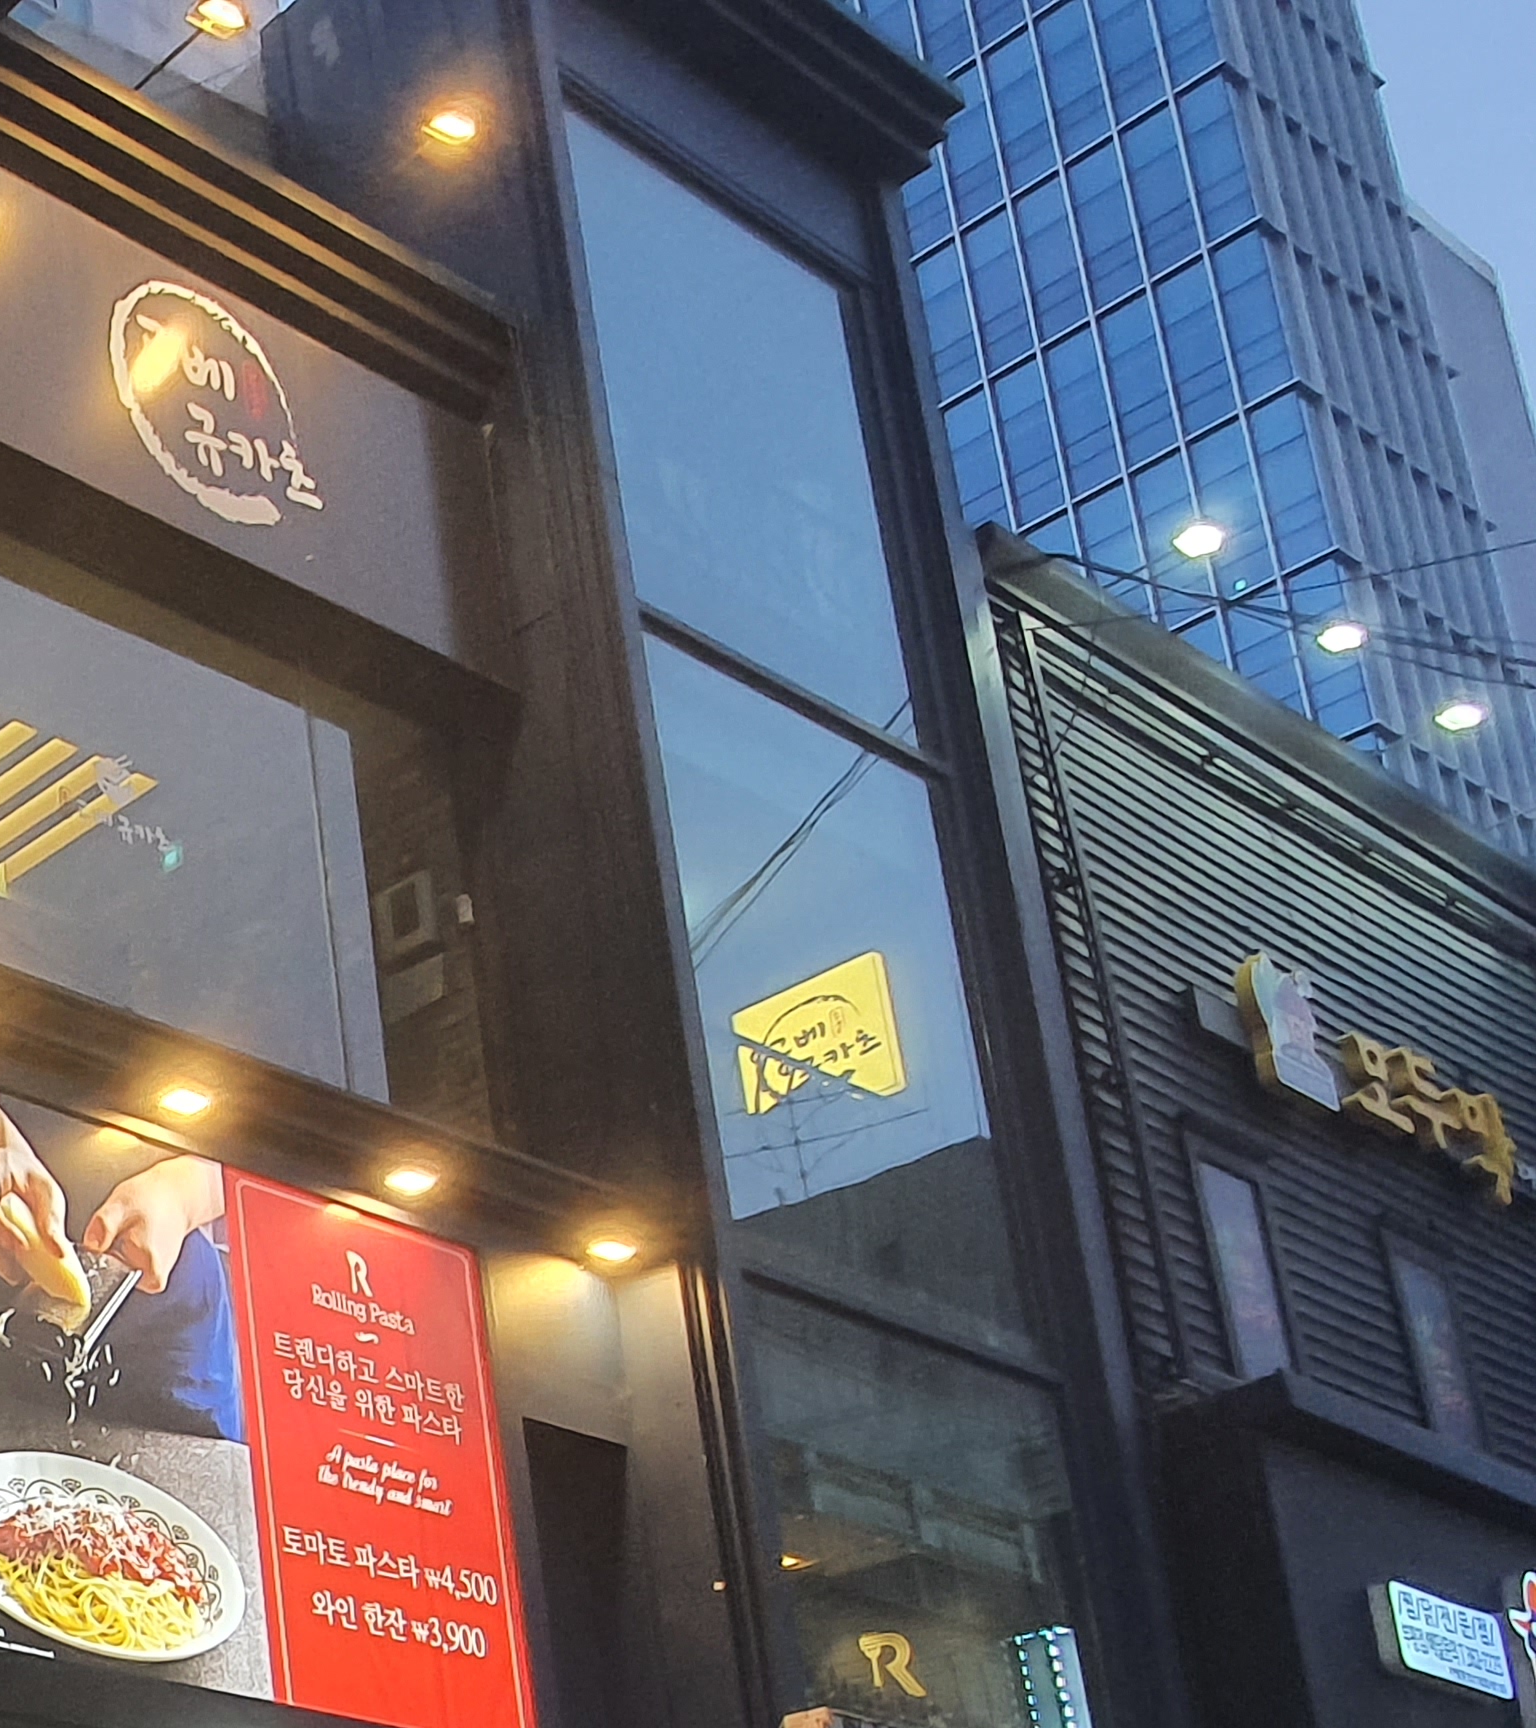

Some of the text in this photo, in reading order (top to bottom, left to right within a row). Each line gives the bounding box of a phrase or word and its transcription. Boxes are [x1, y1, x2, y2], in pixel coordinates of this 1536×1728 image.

[184, 402, 324, 510] 규카츠
[312, 1283, 416, 1337] Rolling Pasta
[273, 1332, 465, 1413] 트렌디하고 스마트한
[282, 1367, 463, 1446] 당신을 위한 파스타
[282, 1525, 351, 1569] 토마토
[354, 1543, 420, 1590] 파스타
[312, 1591, 358, 1632] 와인
[363, 1600, 409, 1644] 한잔
